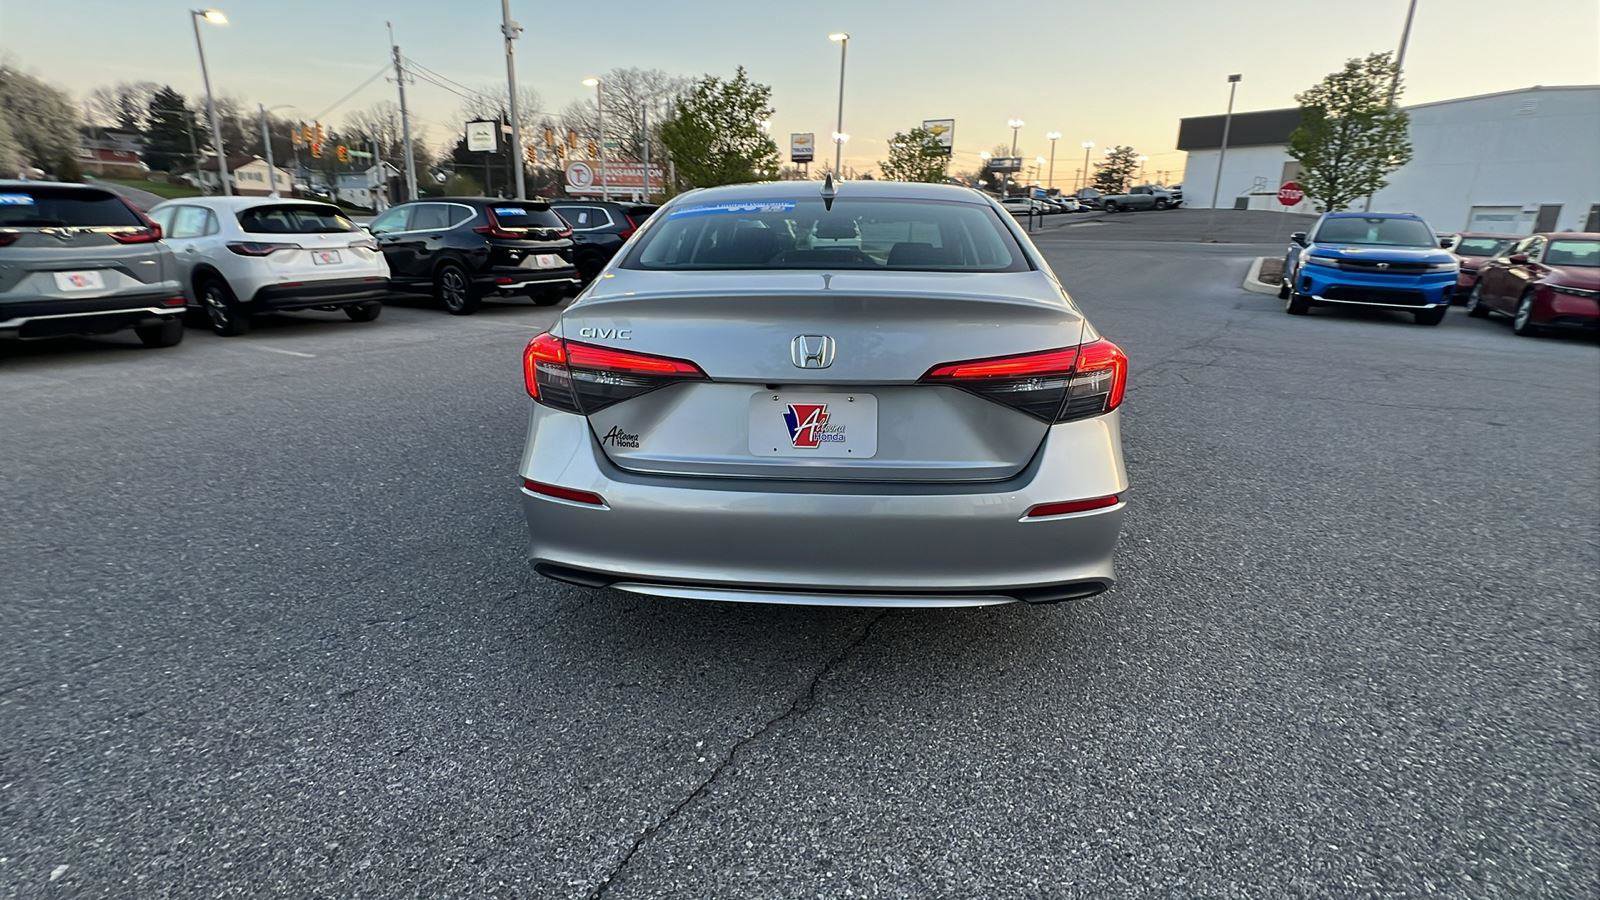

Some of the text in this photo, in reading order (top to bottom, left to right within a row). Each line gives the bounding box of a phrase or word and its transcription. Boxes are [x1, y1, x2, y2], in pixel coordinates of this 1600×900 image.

[595, 167, 663, 178] TRANS4MATON
[1279, 189, 1304, 199] STOP
[579, 327, 632, 340] CIVIC
[793, 408, 845, 443] Altoona
[602, 425, 639, 446] Altoona
[813, 431, 844, 442] Honda
[616, 439, 640, 449] Honda
